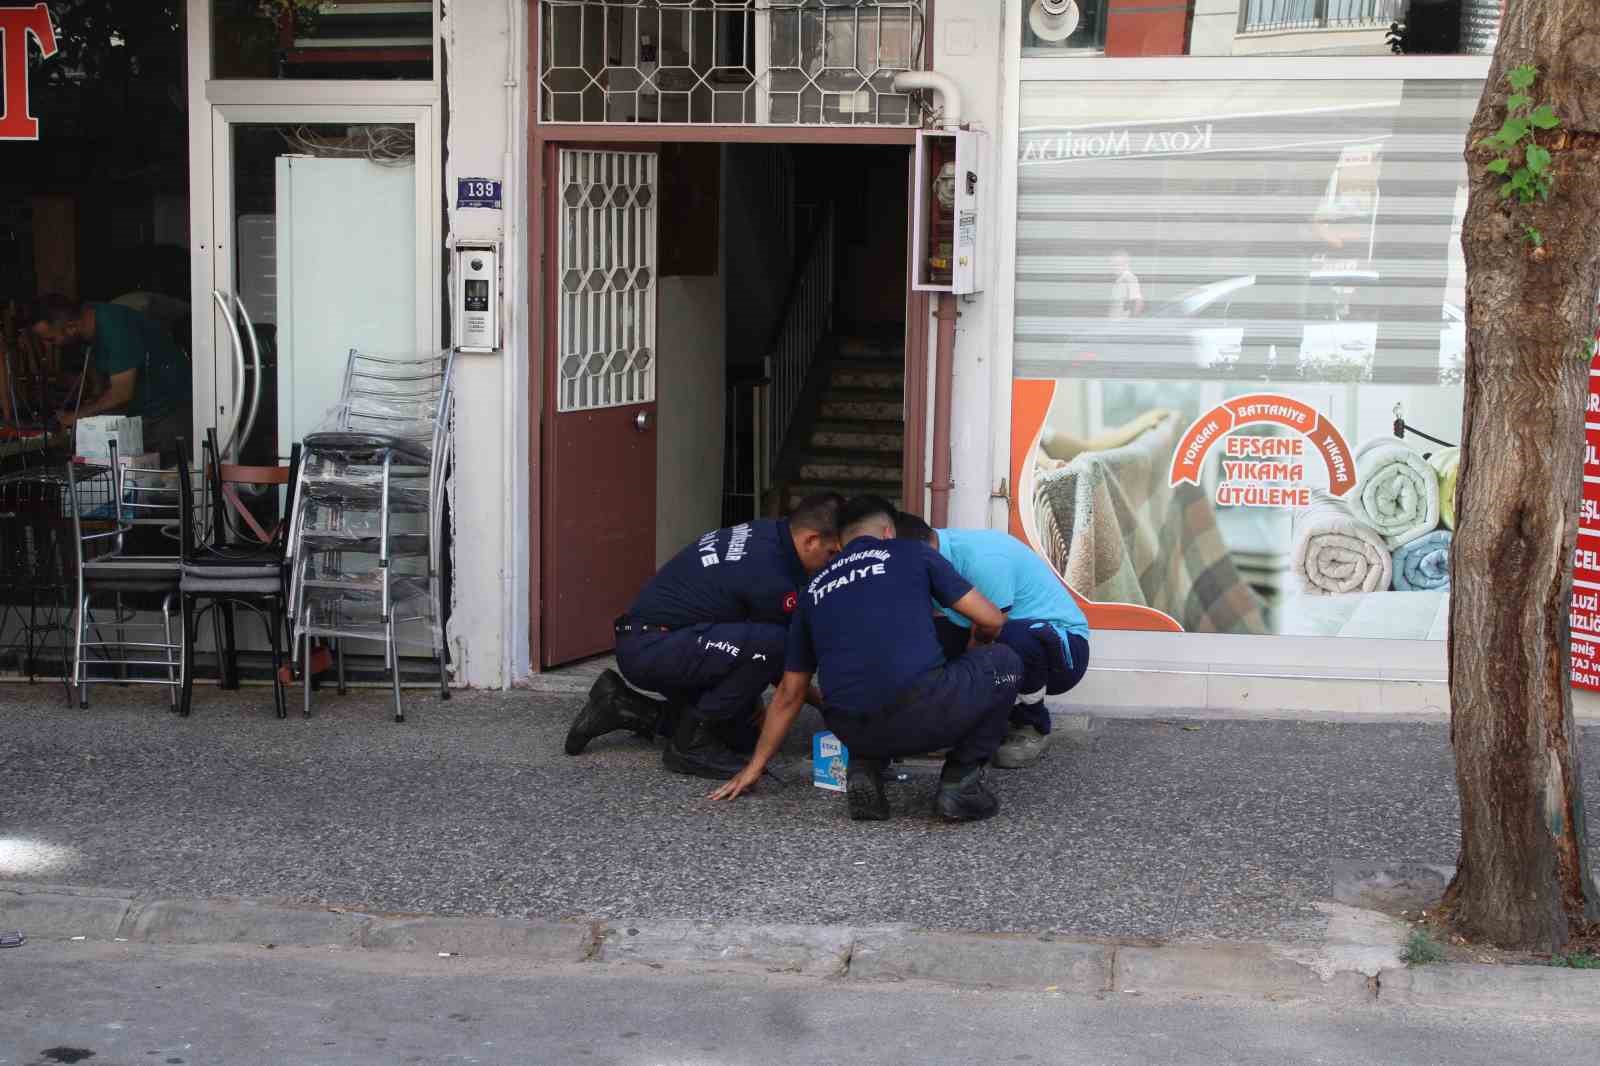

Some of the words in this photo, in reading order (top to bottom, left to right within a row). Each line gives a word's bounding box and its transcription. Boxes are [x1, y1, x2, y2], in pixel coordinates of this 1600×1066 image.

[468, 182, 494, 197] 139
[1237, 403, 1307, 424] BATTANİYE
[1183, 420, 1219, 466] YORGAN
[1226, 437, 1303, 456] EFSANE
[1321, 435, 1348, 483] YIKAMA
[1223, 461, 1303, 481] YIKAMA
[1216, 484, 1311, 506] ÜTÜLEME
